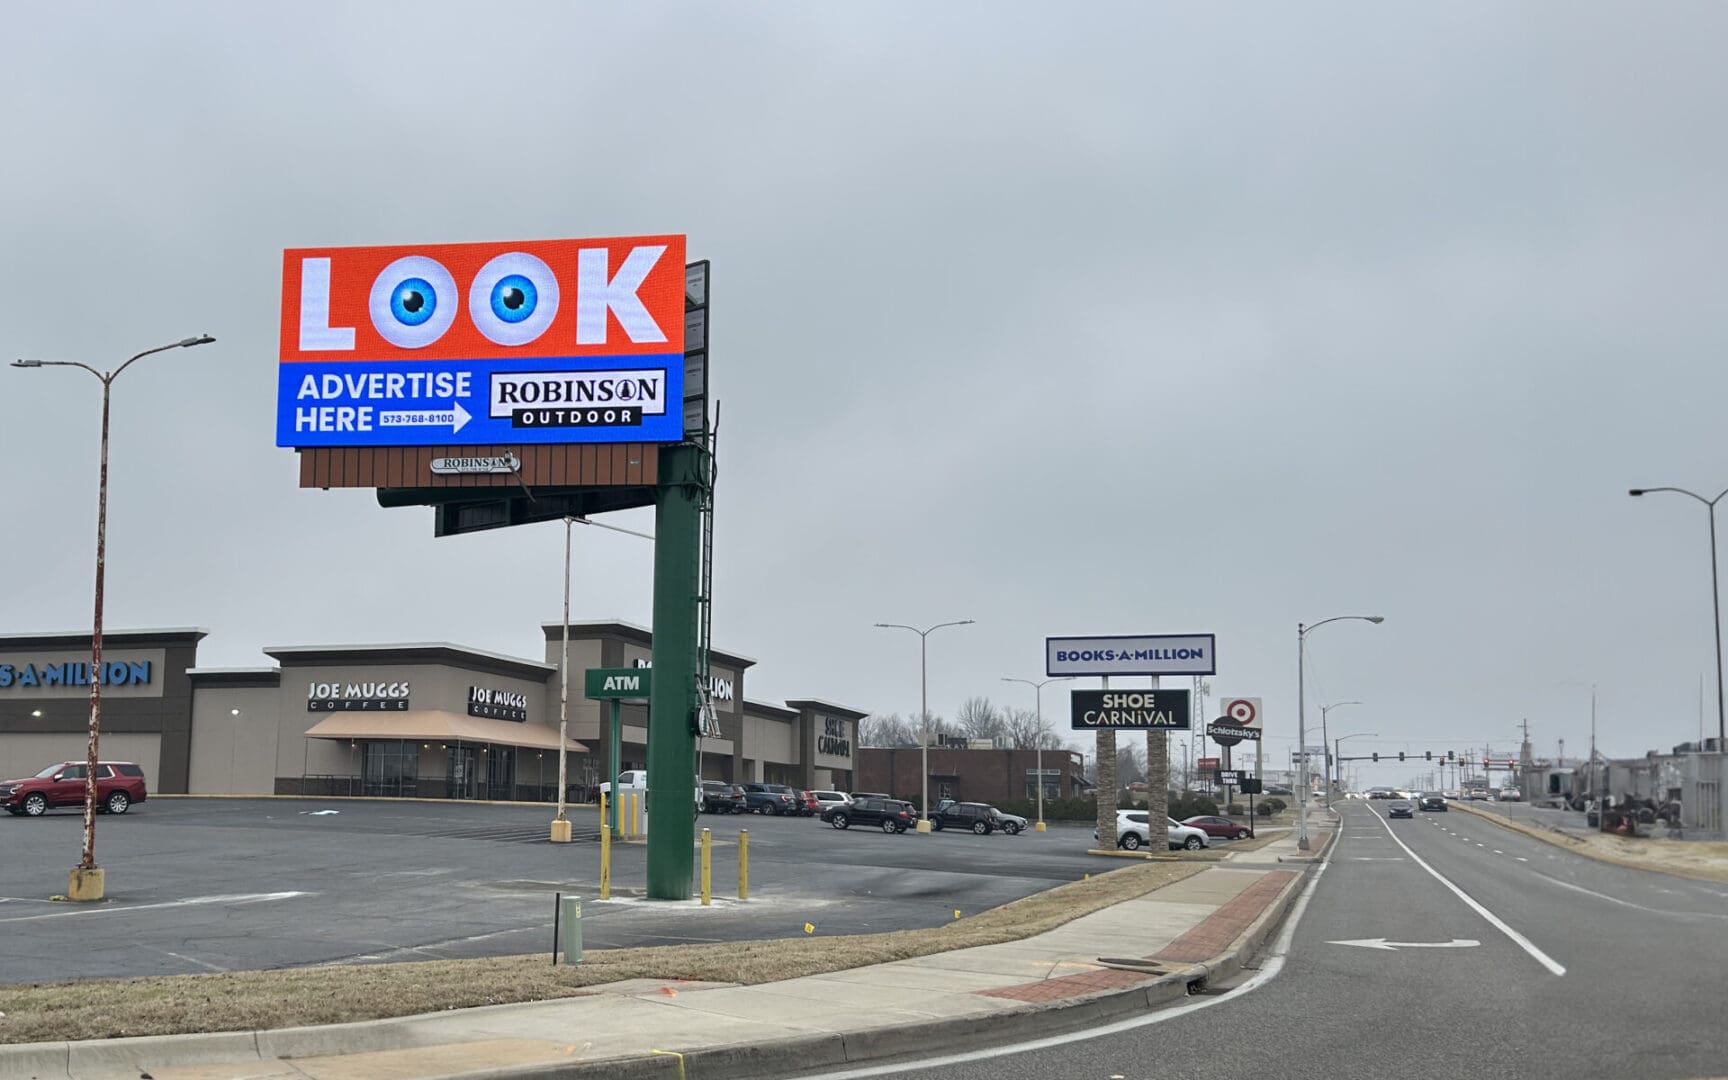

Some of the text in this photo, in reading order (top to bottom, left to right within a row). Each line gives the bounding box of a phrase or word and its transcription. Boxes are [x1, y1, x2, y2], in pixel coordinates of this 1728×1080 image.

[298, 245, 669, 352] LOOK
[297, 371, 472, 400] ADVERTISE
[498, 378, 659, 403] ROBINSON
[295, 405, 373, 432] HERE
[522, 409, 632, 425] OUTDOOR
[308, 681, 410, 699] JOE MUGGS
[603, 675, 639, 691] ATM
[310, 701, 405, 710] COFFEE
[471, 686, 527, 709] JOE MUGGS
[1102, 693, 1155, 709] SHOE
[1207, 725, 1260, 739] Schlotzsky's
